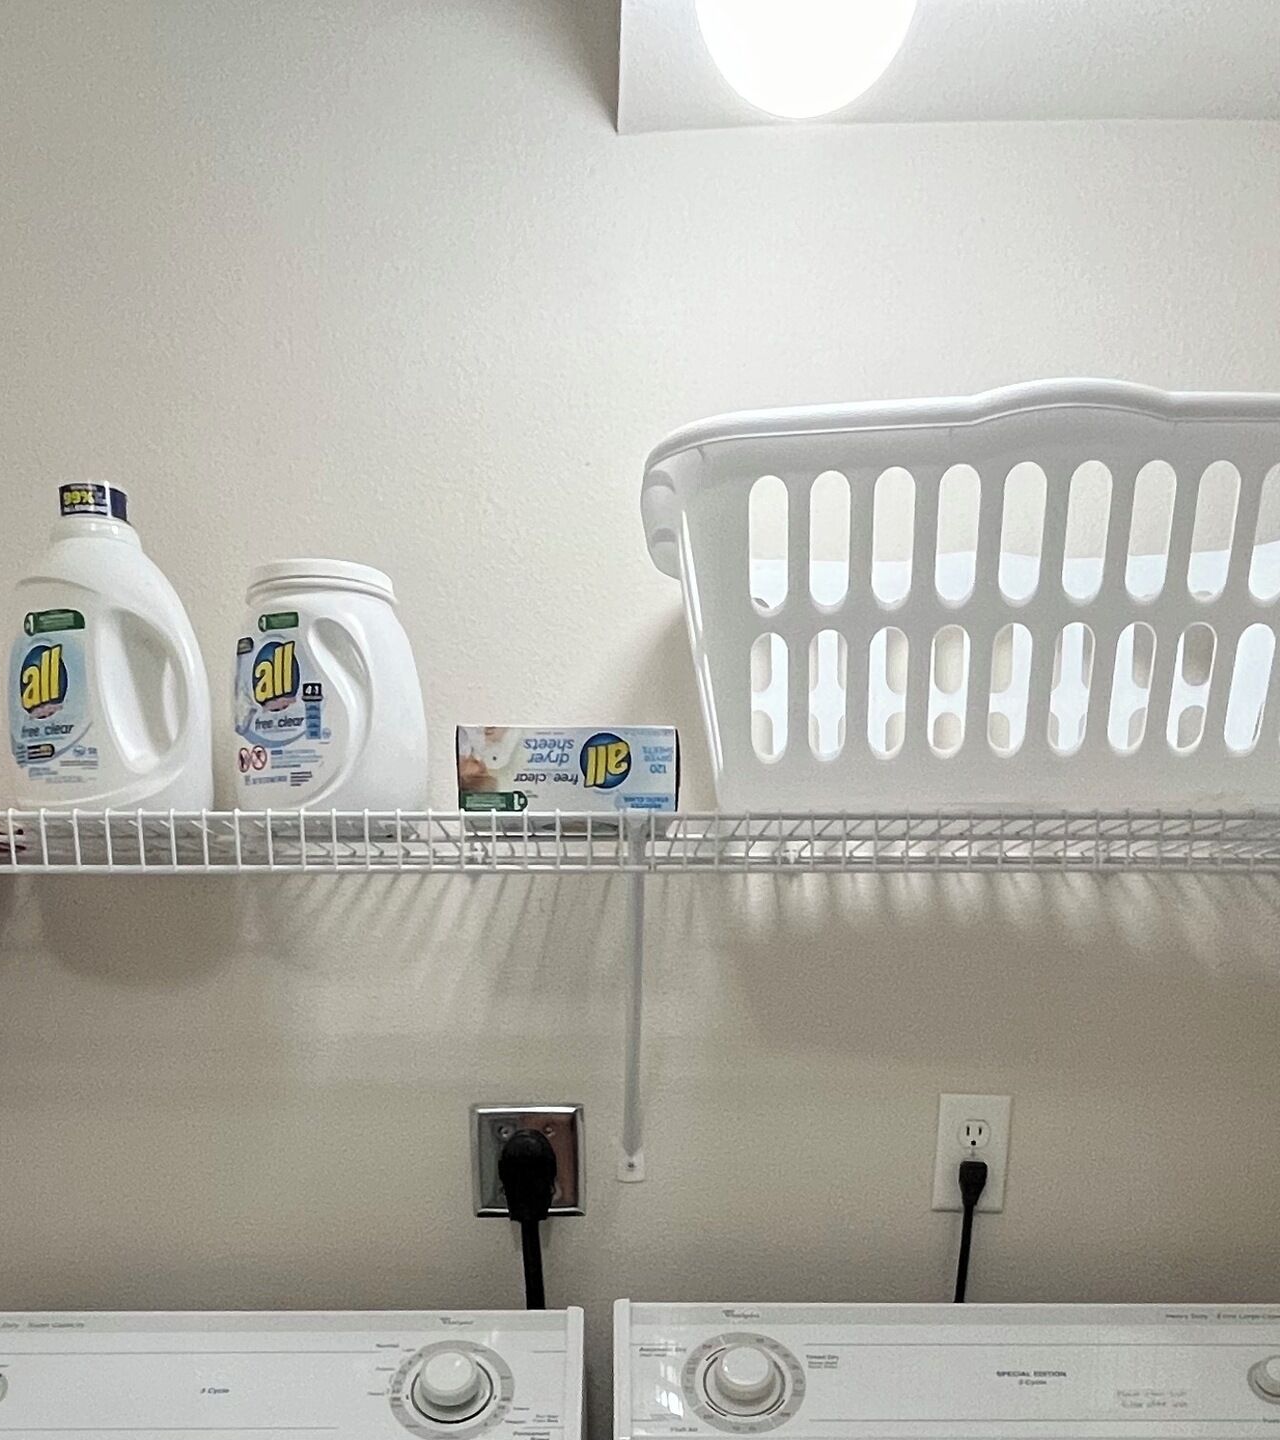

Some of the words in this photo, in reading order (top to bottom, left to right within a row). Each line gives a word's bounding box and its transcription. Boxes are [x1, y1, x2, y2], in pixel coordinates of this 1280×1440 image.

[22, 644, 62, 710] all
[255, 641, 296, 704] all
[44, 722, 75, 736] clear
[278, 716, 304, 728] clear
[523, 738, 575, 752] sheets
[527, 750, 570, 767] dryer
[584, 741, 631, 788] all
[649, 764, 667, 774] 120
[513, 773, 547, 784] clear
[553, 772, 579, 785] free
